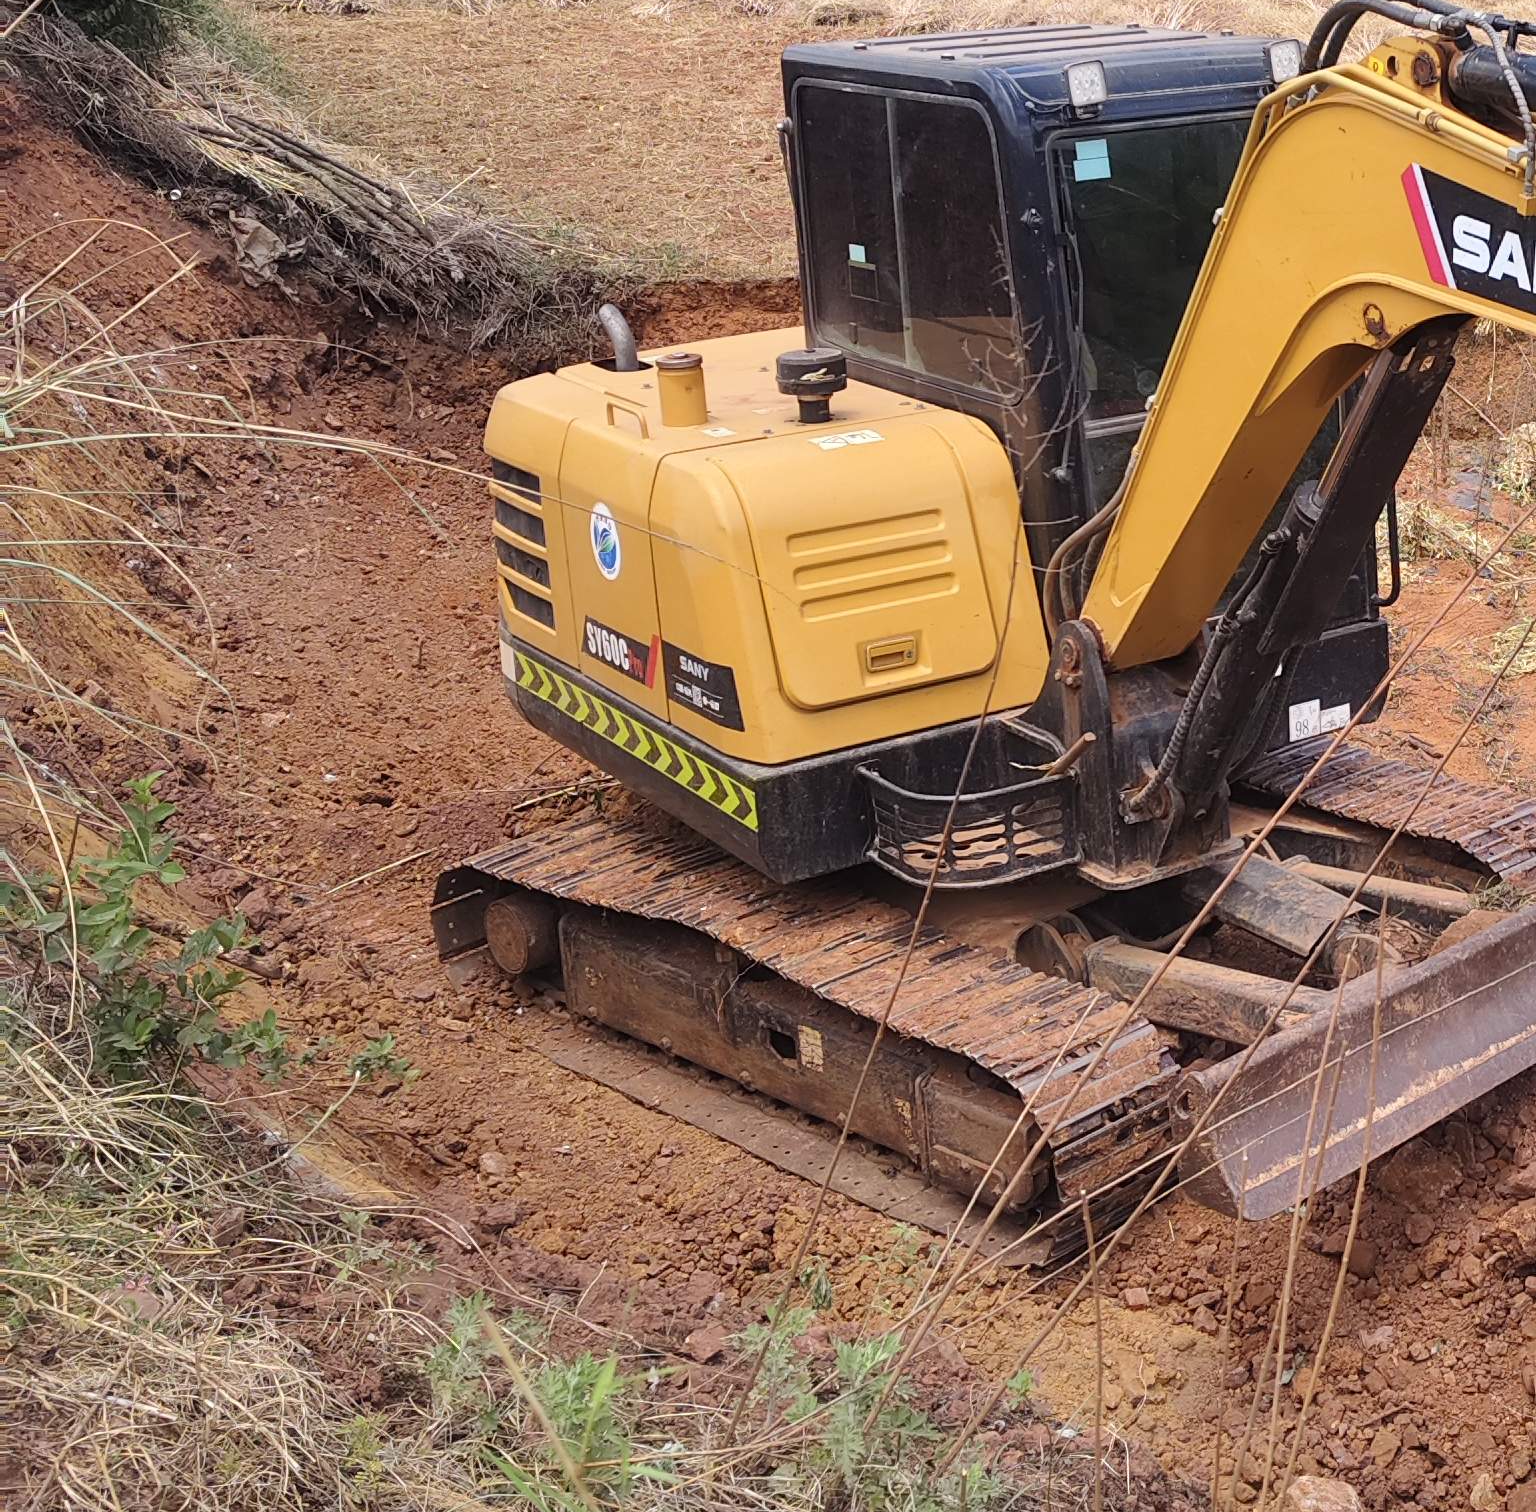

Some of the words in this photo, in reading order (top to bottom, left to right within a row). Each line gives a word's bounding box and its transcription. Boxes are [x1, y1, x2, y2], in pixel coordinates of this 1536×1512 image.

[586, 622, 630, 671] SY60C
[679, 655, 709, 682] SANY
[1295, 719, 1310, 738] 98
